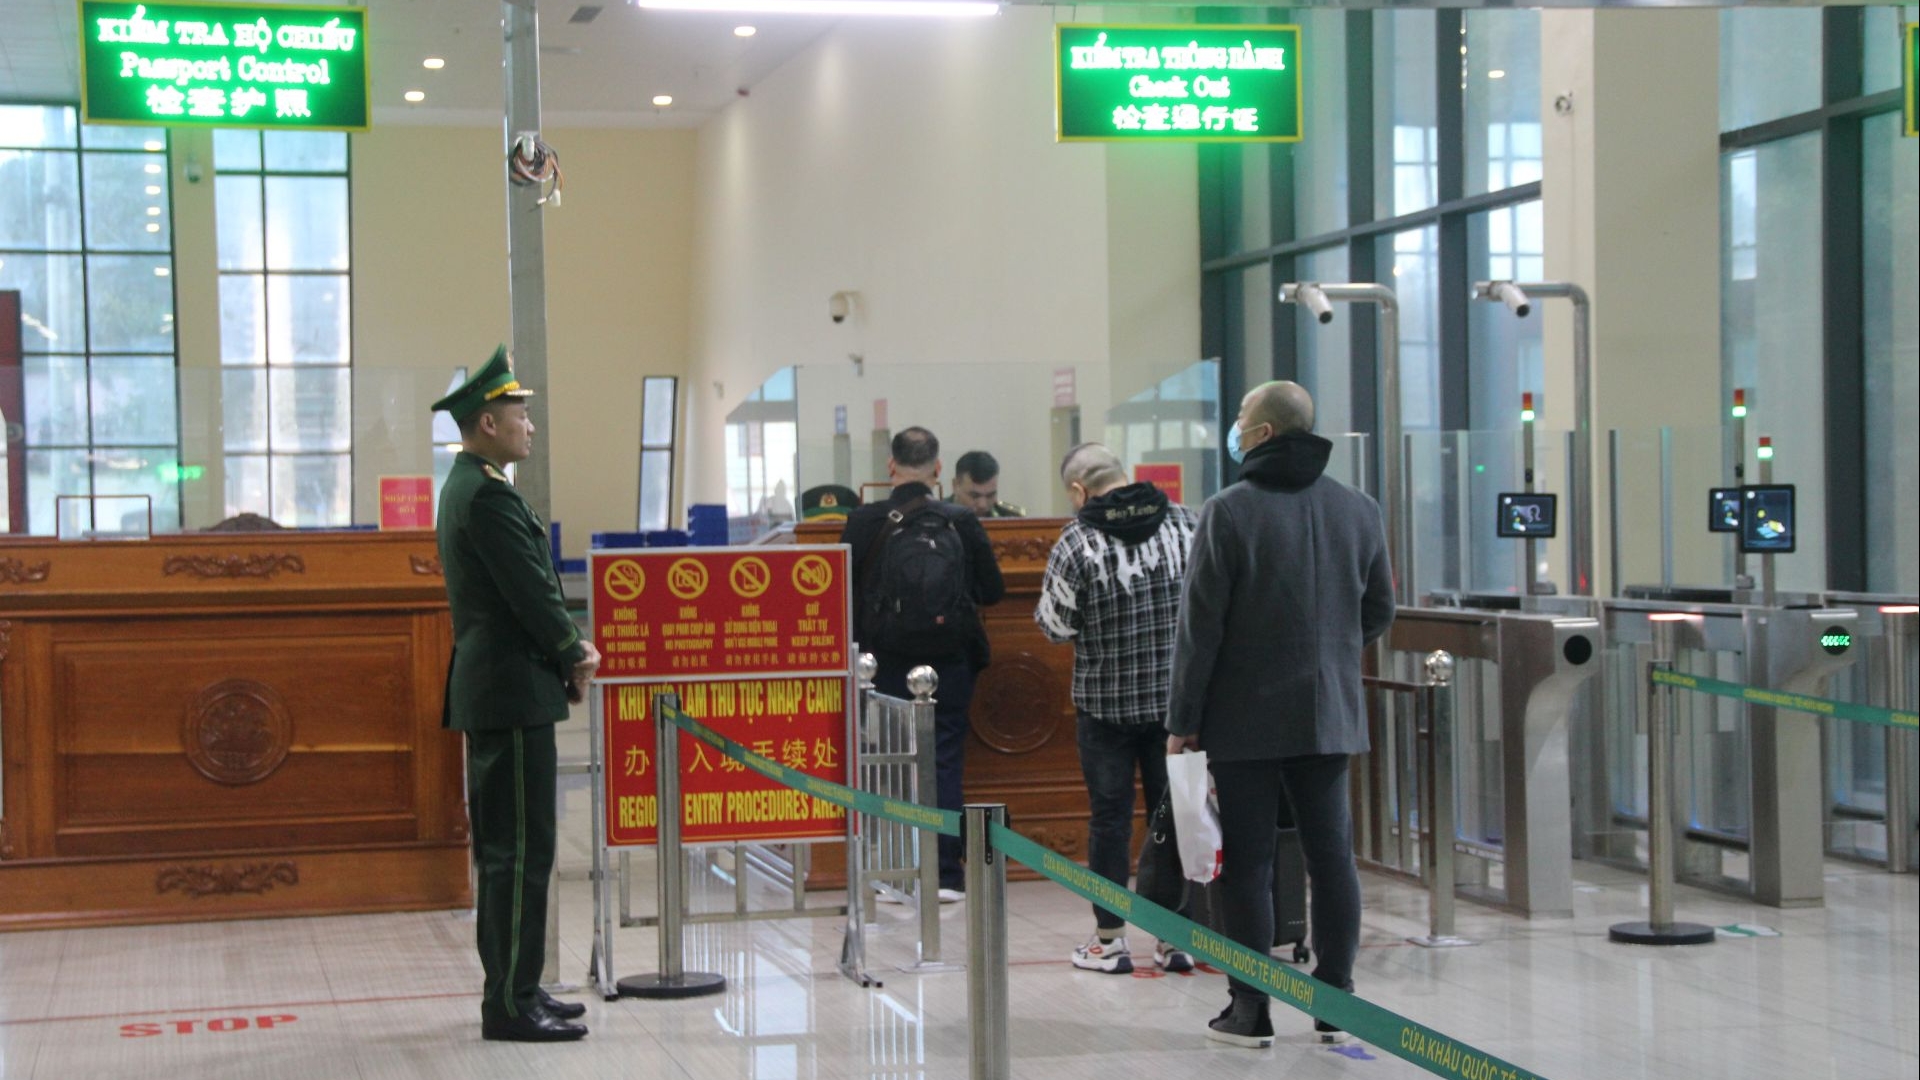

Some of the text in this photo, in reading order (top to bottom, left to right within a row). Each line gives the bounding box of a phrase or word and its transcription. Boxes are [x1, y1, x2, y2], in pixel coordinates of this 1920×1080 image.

[97, 4, 357, 53] KIỂM TRA HỘ CHIẾU
[119, 52, 331, 86] Passport Control
[1123, 46, 1161, 70] TRA
[145, 84, 312, 118] 检查护照
[1129, 74, 1231, 98] Check Out
[1112, 102, 1259, 132] 检查通行证
[613, 607, 637, 621] KHÔNG
[606, 641, 646, 652] NO SMOKING
[665, 640, 674, 650] NO
[791, 635, 835, 646] KEEP SILENT
[619, 685, 646, 721] KHU
[738, 680, 764, 724] TỤC
[619, 796, 657, 828] REGIO
[684, 792, 724, 825] ENTRY
[727, 789, 809, 822] PROCEDURES
[1192, 928, 1208, 952] CỬA
[1232, 950, 1257, 977] QUỐC
[1258, 959, 1269, 983] TẾ
[1270, 966, 1290, 993] HỮU
[1290, 978, 1314, 1009] NGHỊ
[119, 1014, 299, 1038] STOP
[1401, 1026, 1425, 1056] CỬA
